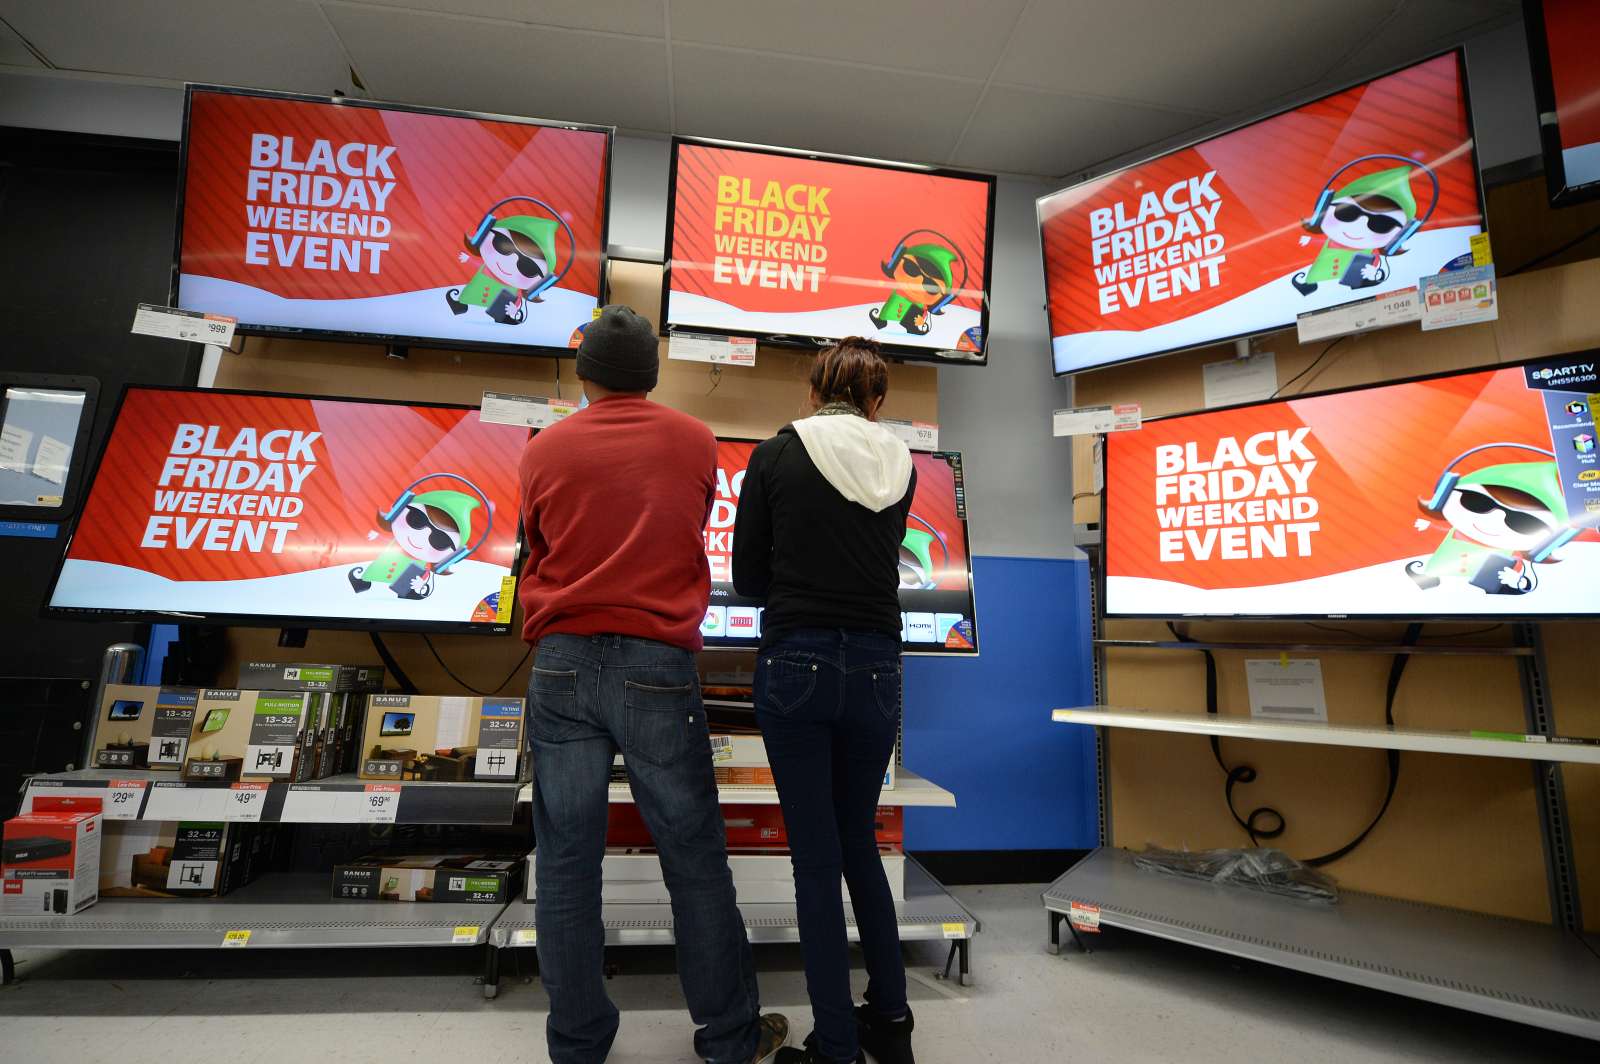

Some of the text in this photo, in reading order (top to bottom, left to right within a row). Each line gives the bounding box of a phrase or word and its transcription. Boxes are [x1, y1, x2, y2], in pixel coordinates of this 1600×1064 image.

[250, 133, 398, 179] BLACK
[246, 170, 396, 212] FRIDAY
[717, 175, 832, 216] BLACK
[1089, 170, 1220, 239] BLACK
[246, 205, 391, 238] WEEKEND
[714, 204, 831, 242] FRIDAY
[1092, 201, 1222, 266] FRIDAY
[245, 232, 389, 274] EVENT
[714, 234, 828, 262] WEEKEND
[1094, 233, 1226, 286] WEEKEND
[713, 256, 827, 293] EVENT
[1098, 255, 1227, 315] EVENT
[1579, 363, 1594, 373] TV
[170, 424, 321, 462] BLACK
[1155, 426, 1318, 475] BLACK
[158, 458, 316, 493] FRIDAY
[1155, 459, 1318, 505] FRIDAY
[153, 490, 303, 517] WEEKEND
[1156, 496, 1318, 528] WEEKEND
[140, 516, 297, 554] EVENT
[1159, 522, 1320, 563] EVENT
